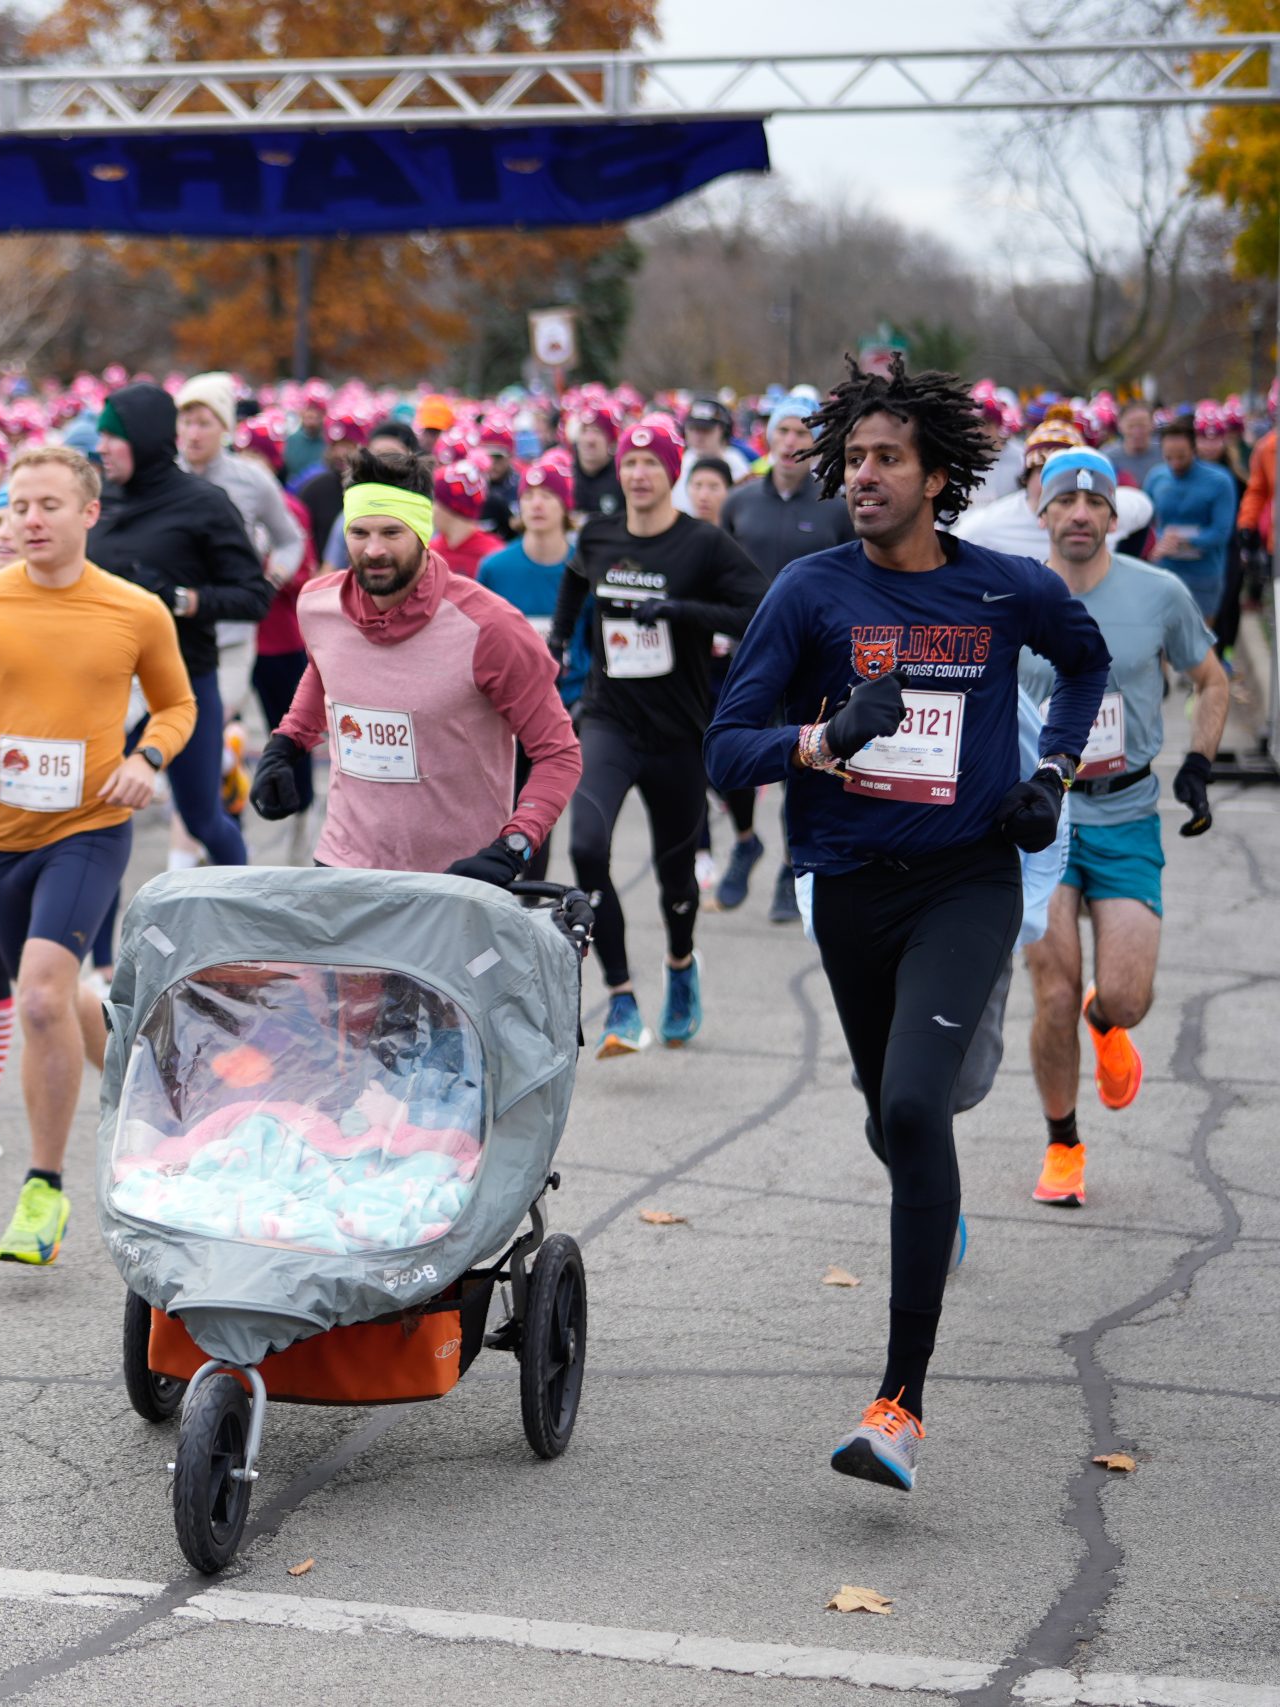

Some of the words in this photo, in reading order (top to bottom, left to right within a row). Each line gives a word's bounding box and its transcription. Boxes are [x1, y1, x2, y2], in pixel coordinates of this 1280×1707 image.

[606, 569, 666, 589] CHICAGO
[901, 664, 933, 677] CROSS
[934, 664, 986, 679] COUNTRY
[900, 707, 952, 737] 3121
[366, 723, 409, 747] 1982
[39, 754, 70, 777] 815
[931, 787, 951, 797] 3121
